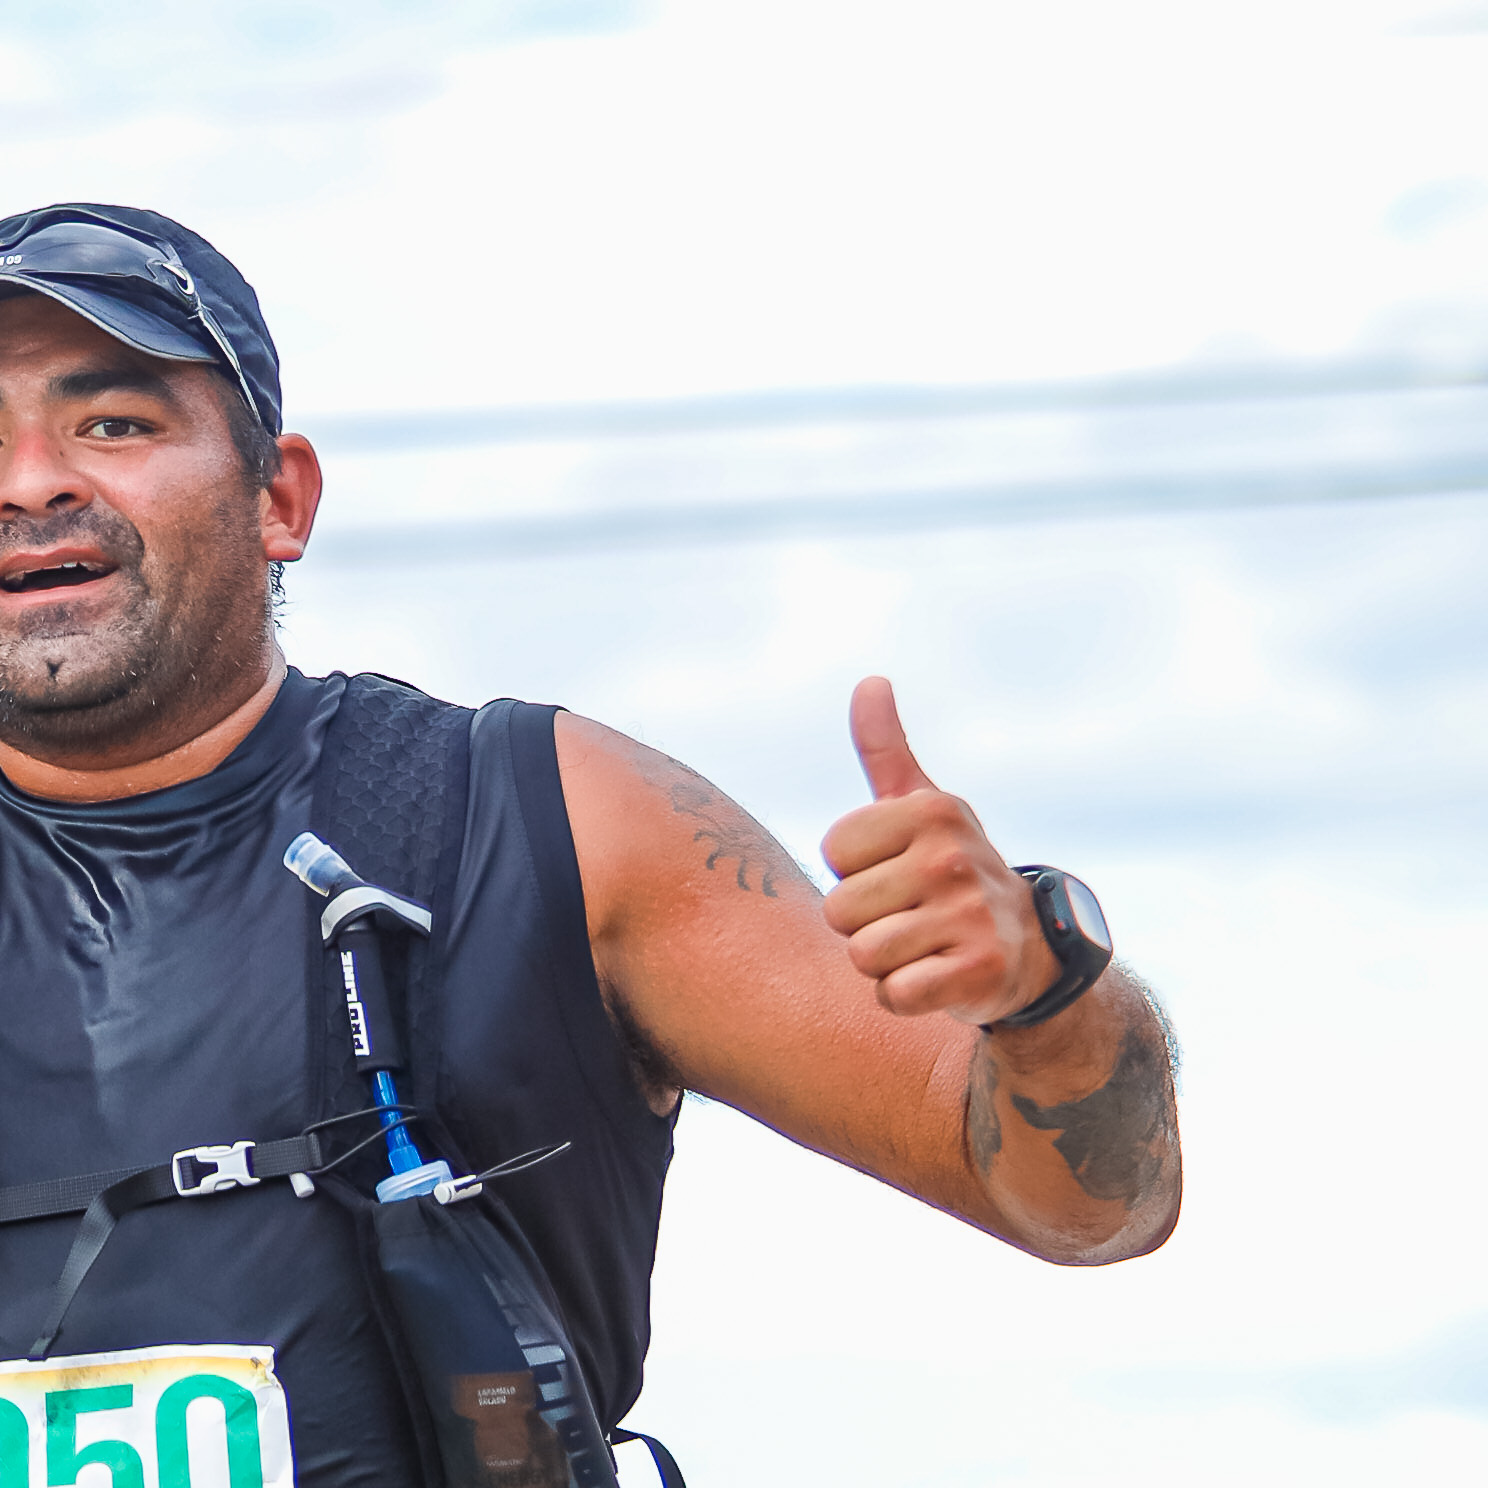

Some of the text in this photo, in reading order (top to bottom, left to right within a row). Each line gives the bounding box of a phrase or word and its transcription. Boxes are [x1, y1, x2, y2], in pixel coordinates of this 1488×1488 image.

[5, 254, 22, 265] GO
[340, 951, 368, 1053] PRO LINE
